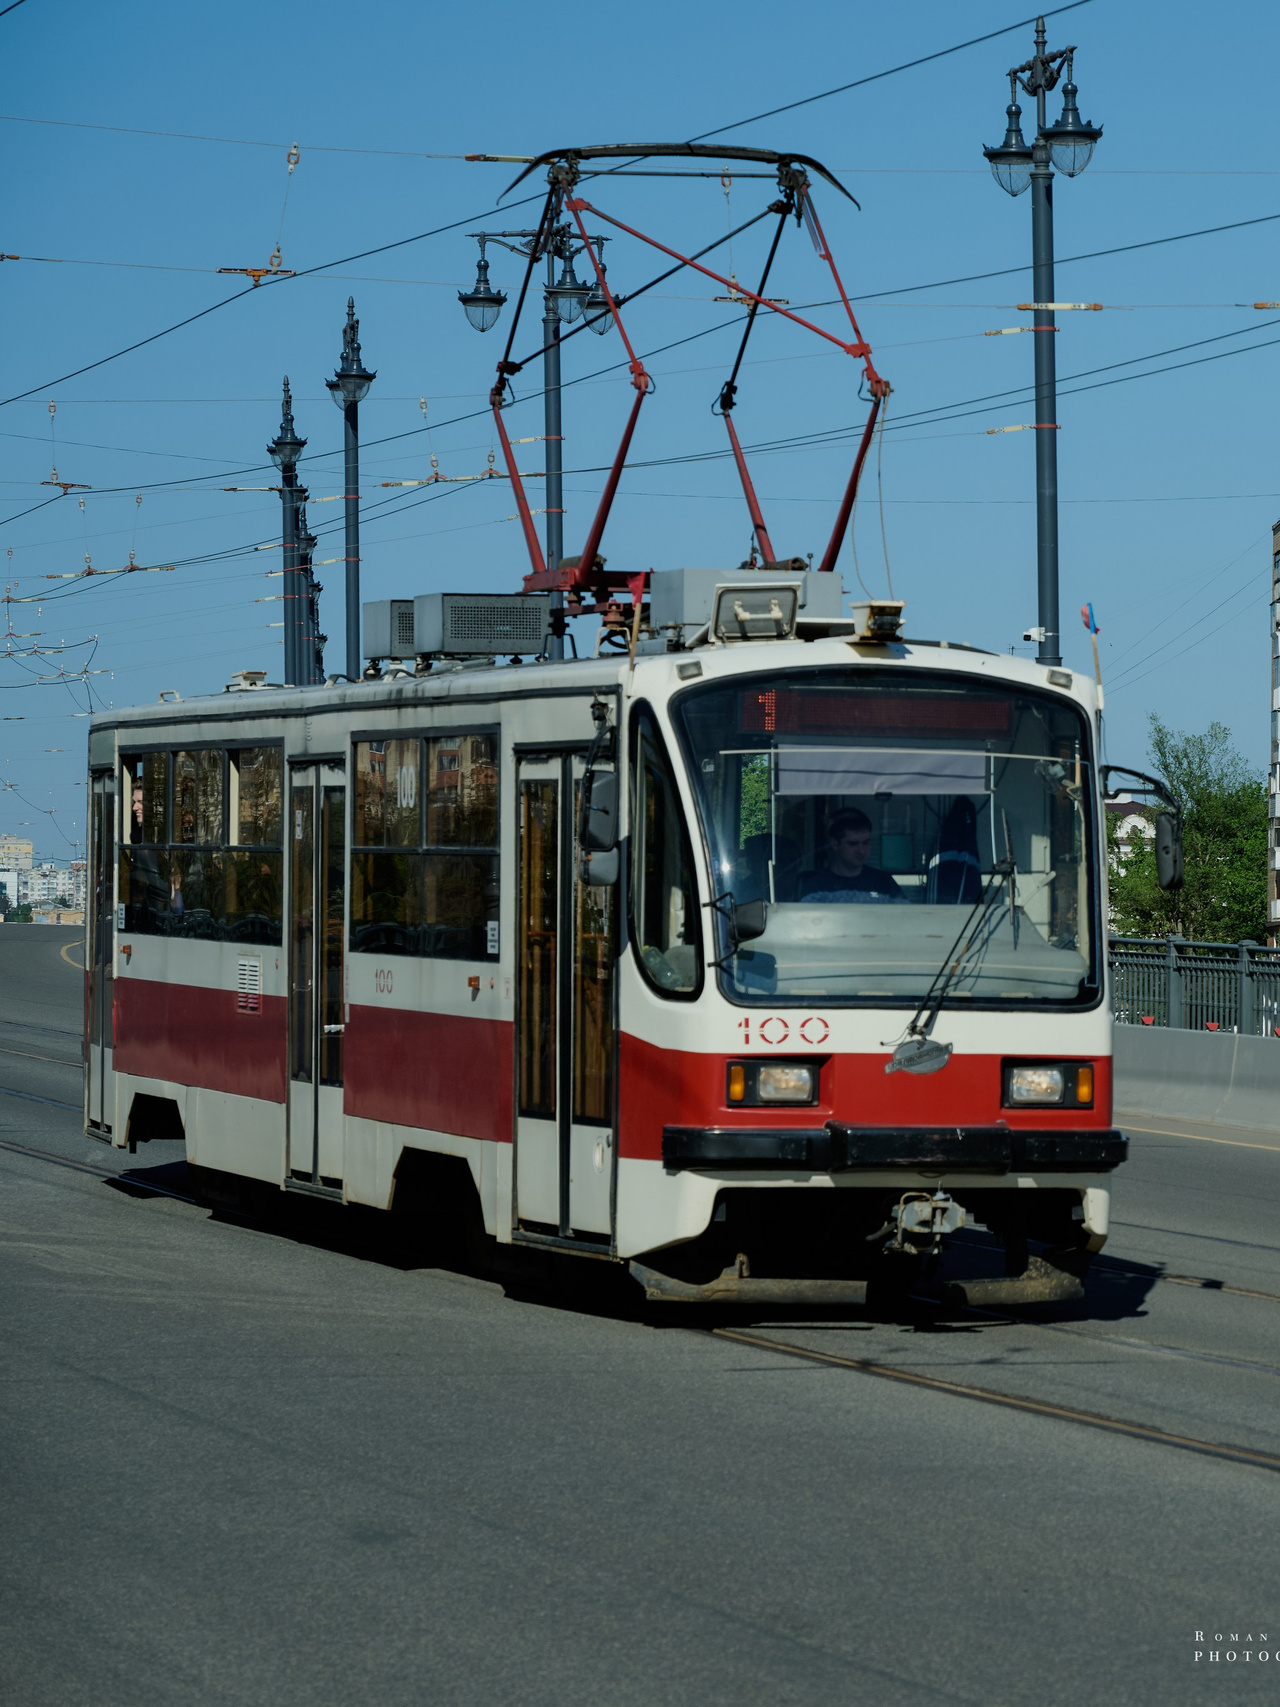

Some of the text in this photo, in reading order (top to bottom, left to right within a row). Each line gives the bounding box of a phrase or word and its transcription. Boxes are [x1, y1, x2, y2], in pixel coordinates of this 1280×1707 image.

[758, 689, 776, 731] 1
[396, 766, 416, 809] 100
[375, 969, 393, 993] 100
[737, 1017, 830, 1045] 100
